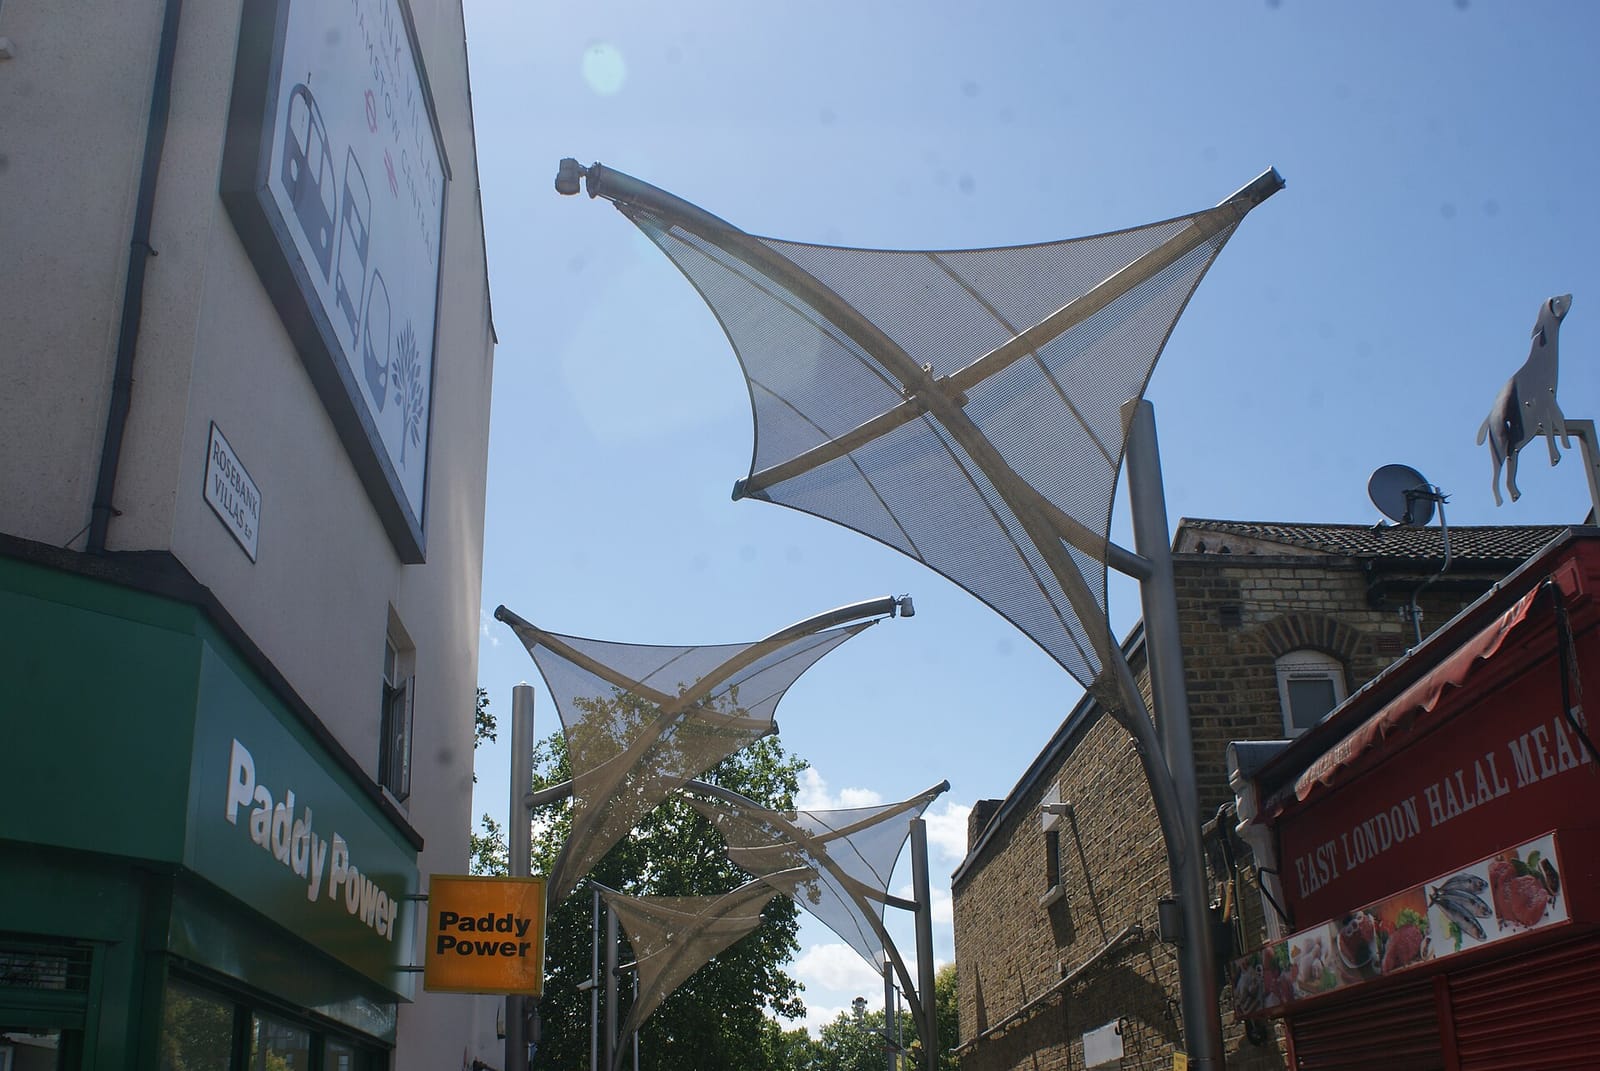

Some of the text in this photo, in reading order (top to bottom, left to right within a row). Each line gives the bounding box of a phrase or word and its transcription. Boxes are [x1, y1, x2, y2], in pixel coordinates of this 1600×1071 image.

[406, 73, 437, 207] VILLAS
[401, 148, 433, 265] CENTRAL
[213, 440, 257, 520] ROSEBANK
[215, 474, 245, 529] VILLAS
[226, 737, 398, 941] Paddy Power
[1295, 704, 1592, 899] EAST LONDON HALAL MEAT
[436, 935, 532, 957] Power
[439, 911, 532, 938] Paddy
